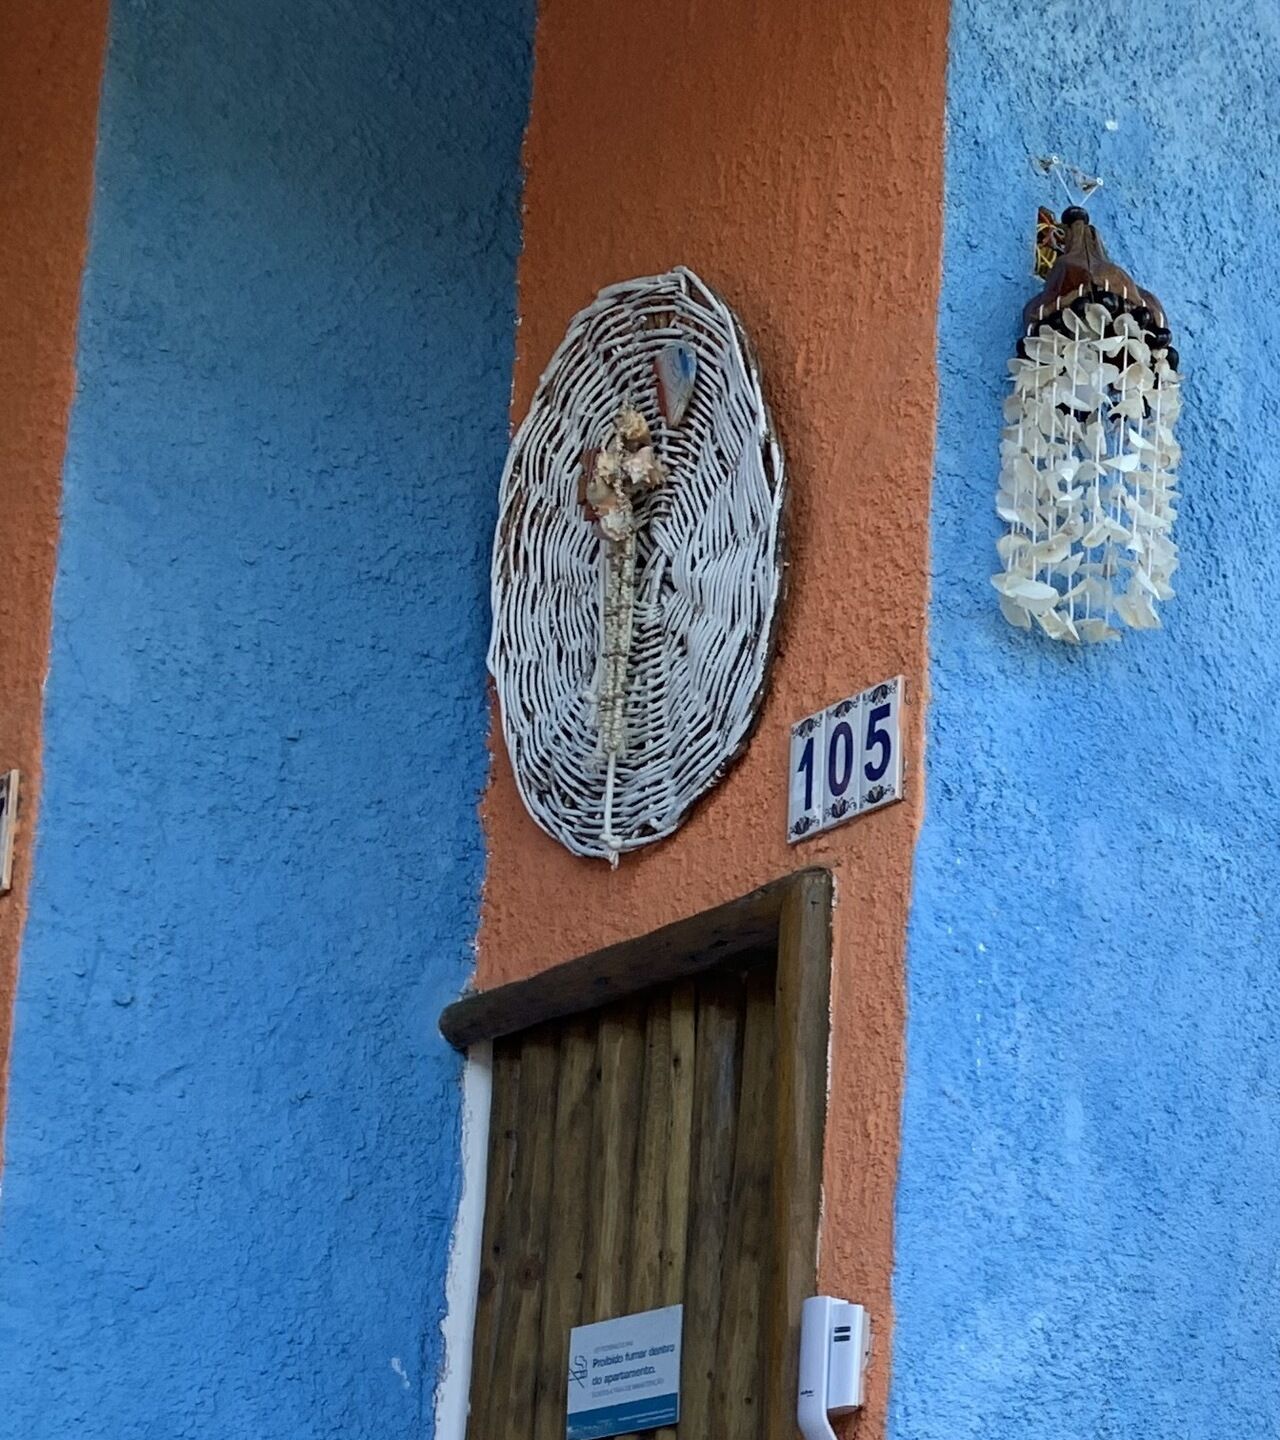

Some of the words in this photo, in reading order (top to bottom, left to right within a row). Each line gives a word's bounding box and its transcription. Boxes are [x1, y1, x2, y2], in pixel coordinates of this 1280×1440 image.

[797, 703, 892, 811] 105
[592, 1353, 624, 1368] Proibido
[625, 1349, 647, 1361] fumar
[648, 1343, 675, 1356] dentro
[592, 1376, 602, 1386] do
